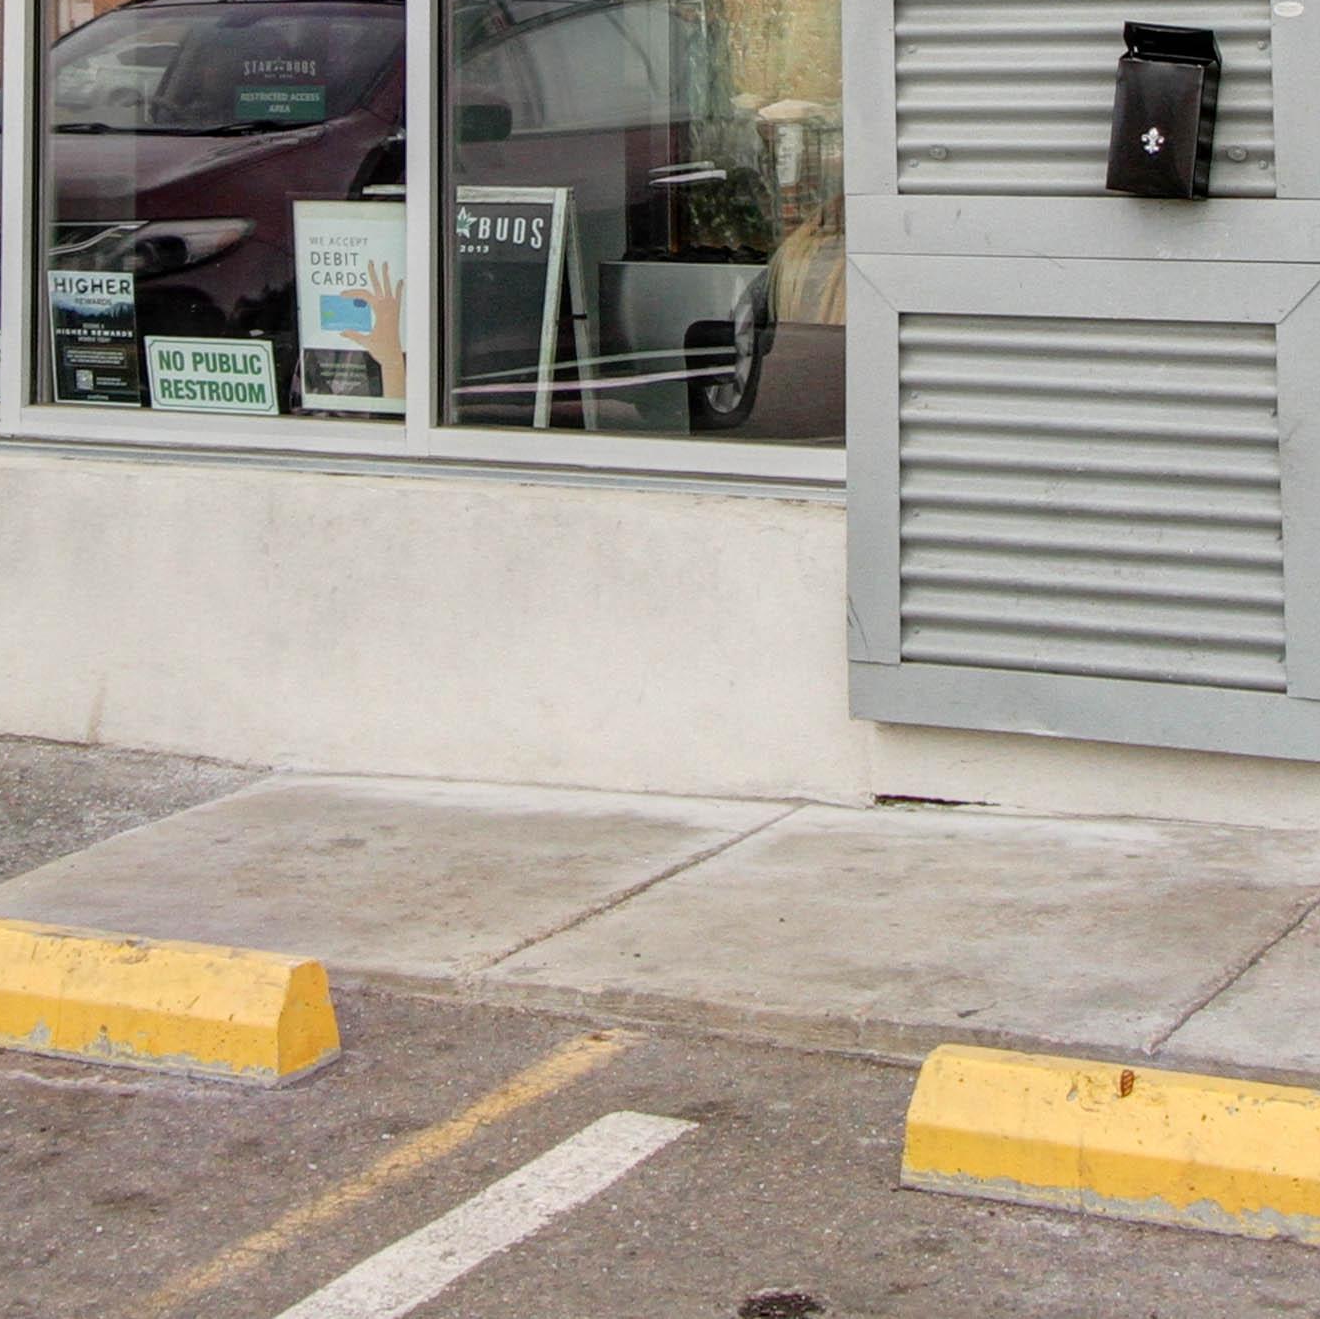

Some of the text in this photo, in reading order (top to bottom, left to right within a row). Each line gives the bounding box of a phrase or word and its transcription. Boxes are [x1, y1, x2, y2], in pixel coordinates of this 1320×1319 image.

[309, 236, 368, 247] WE ACCEPT
[478, 216, 545, 250] BUDS
[459, 244, 490, 254] 2013
[310, 251, 359, 267] DEBIT
[54, 277, 131, 295] HIGHER
[311, 270, 368, 287] CARDS
[157, 349, 263, 375] NO PUBLIC
[159, 378, 267, 404] RESTROOM
